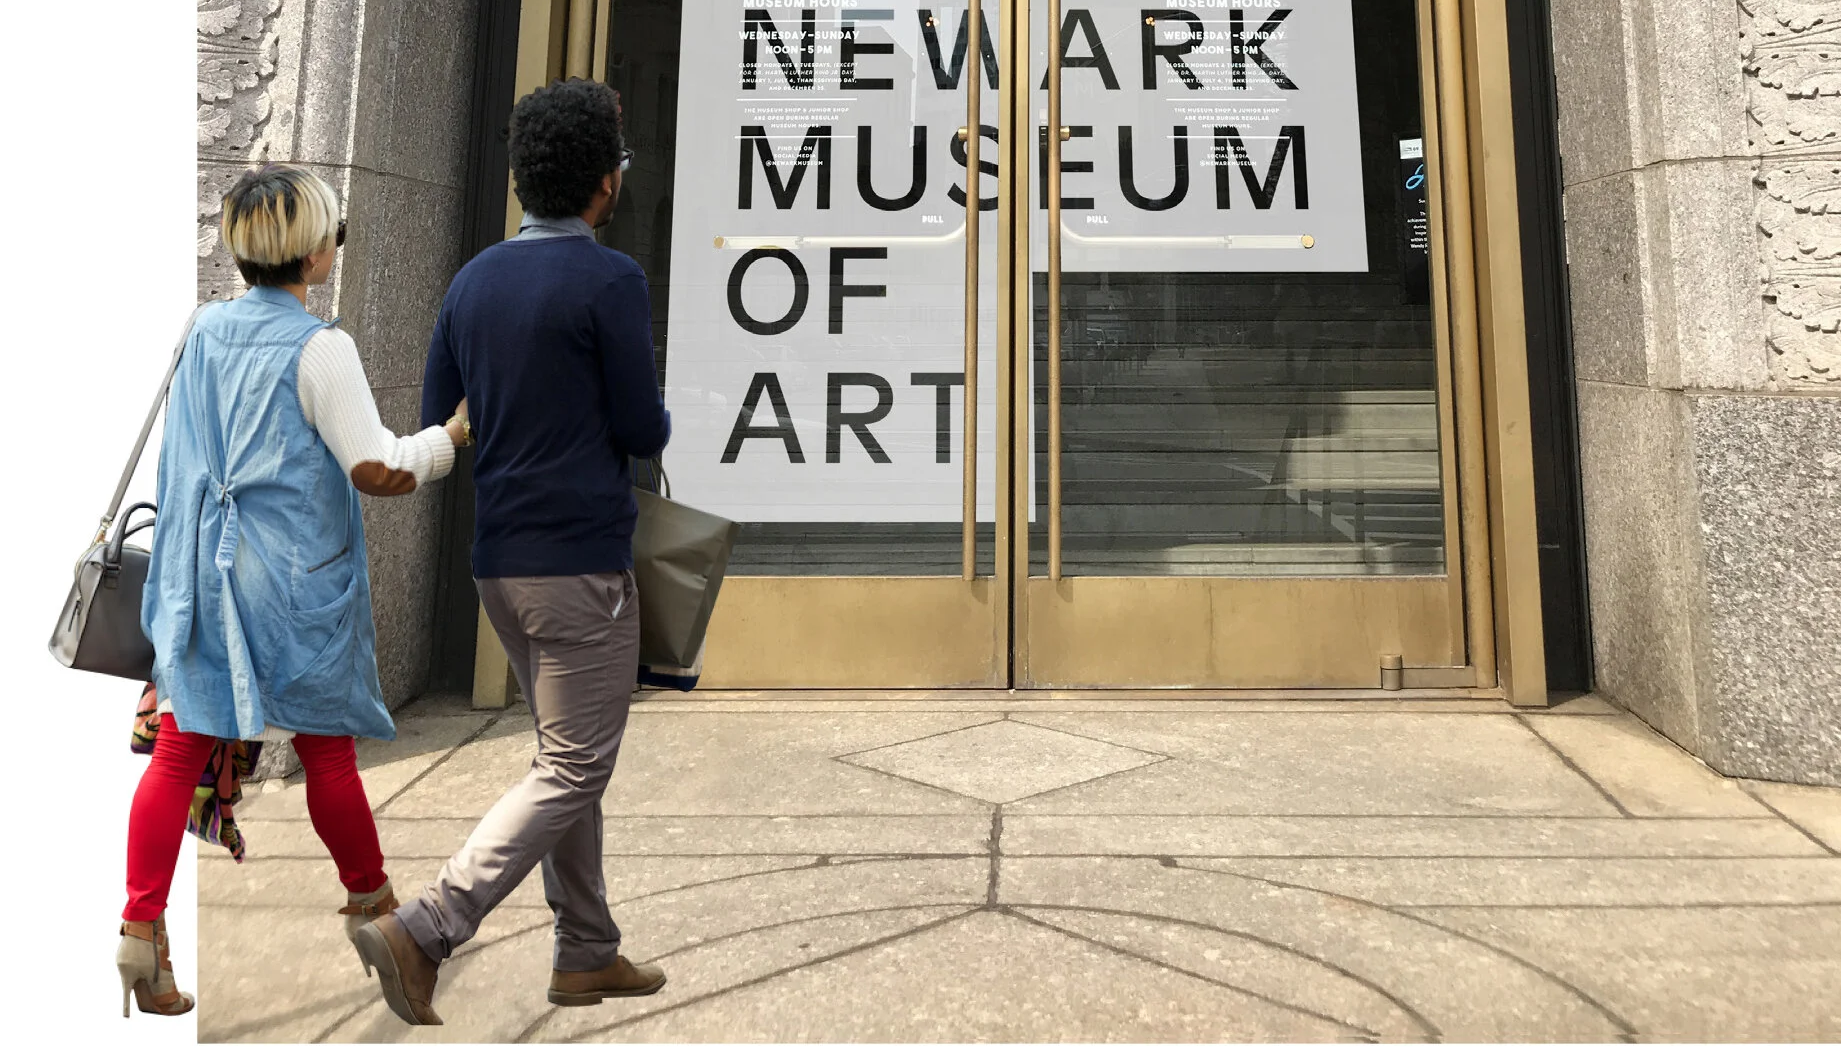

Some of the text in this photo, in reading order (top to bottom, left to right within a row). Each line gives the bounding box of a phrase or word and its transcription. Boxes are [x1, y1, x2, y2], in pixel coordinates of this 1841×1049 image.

[742, 9, 1300, 91] NEWARK
[817, 45, 832, 55] PM
[1243, 45, 1258, 55] PM
[737, 125, 1310, 211] MUSEUM
[922, 215, 944, 224] PULL
[1086, 215, 1108, 224] PULL
[726, 244, 888, 336] OF
[719, 371, 965, 464] ART
